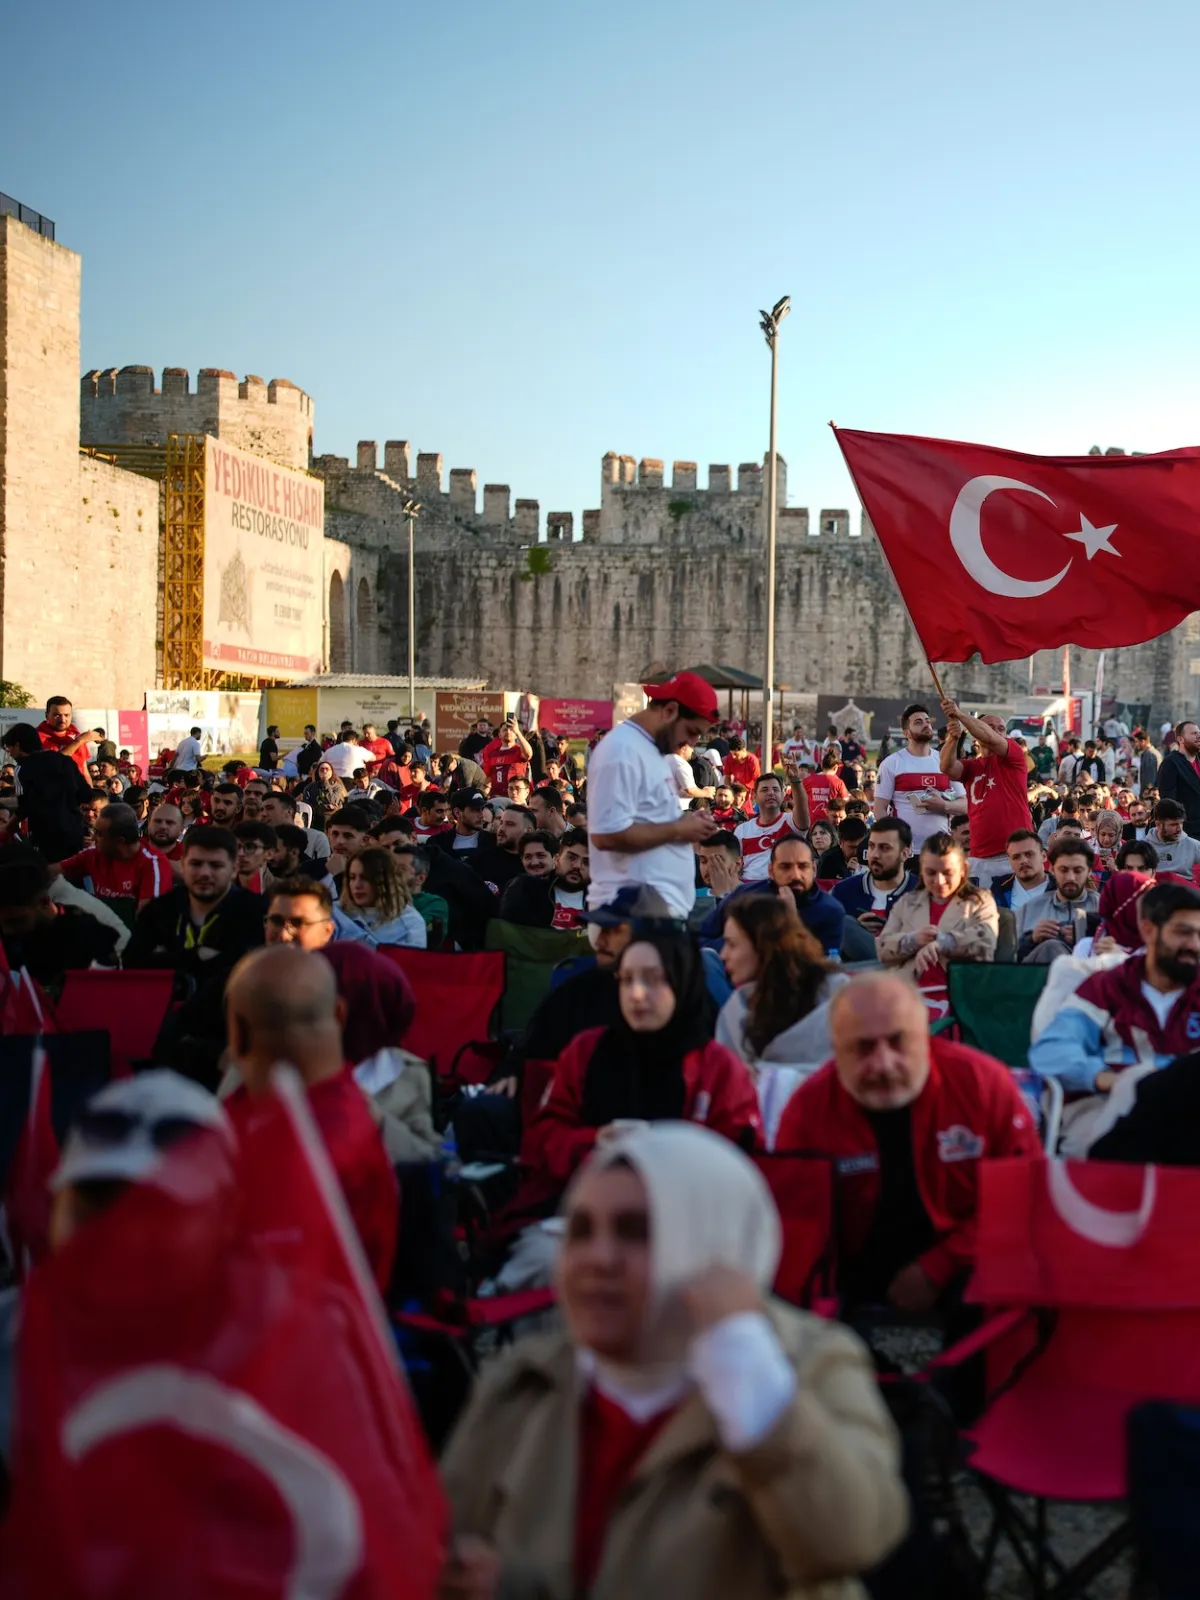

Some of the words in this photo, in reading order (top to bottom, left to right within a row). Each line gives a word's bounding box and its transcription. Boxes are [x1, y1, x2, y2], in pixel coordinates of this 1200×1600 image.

[212, 446, 280, 513] YEDİKULE
[283, 475, 322, 529] HİSARI
[231, 501, 309, 549] RESTORASYONU
[496, 770, 503, 783] 8
[122, 880, 132, 890] 10
